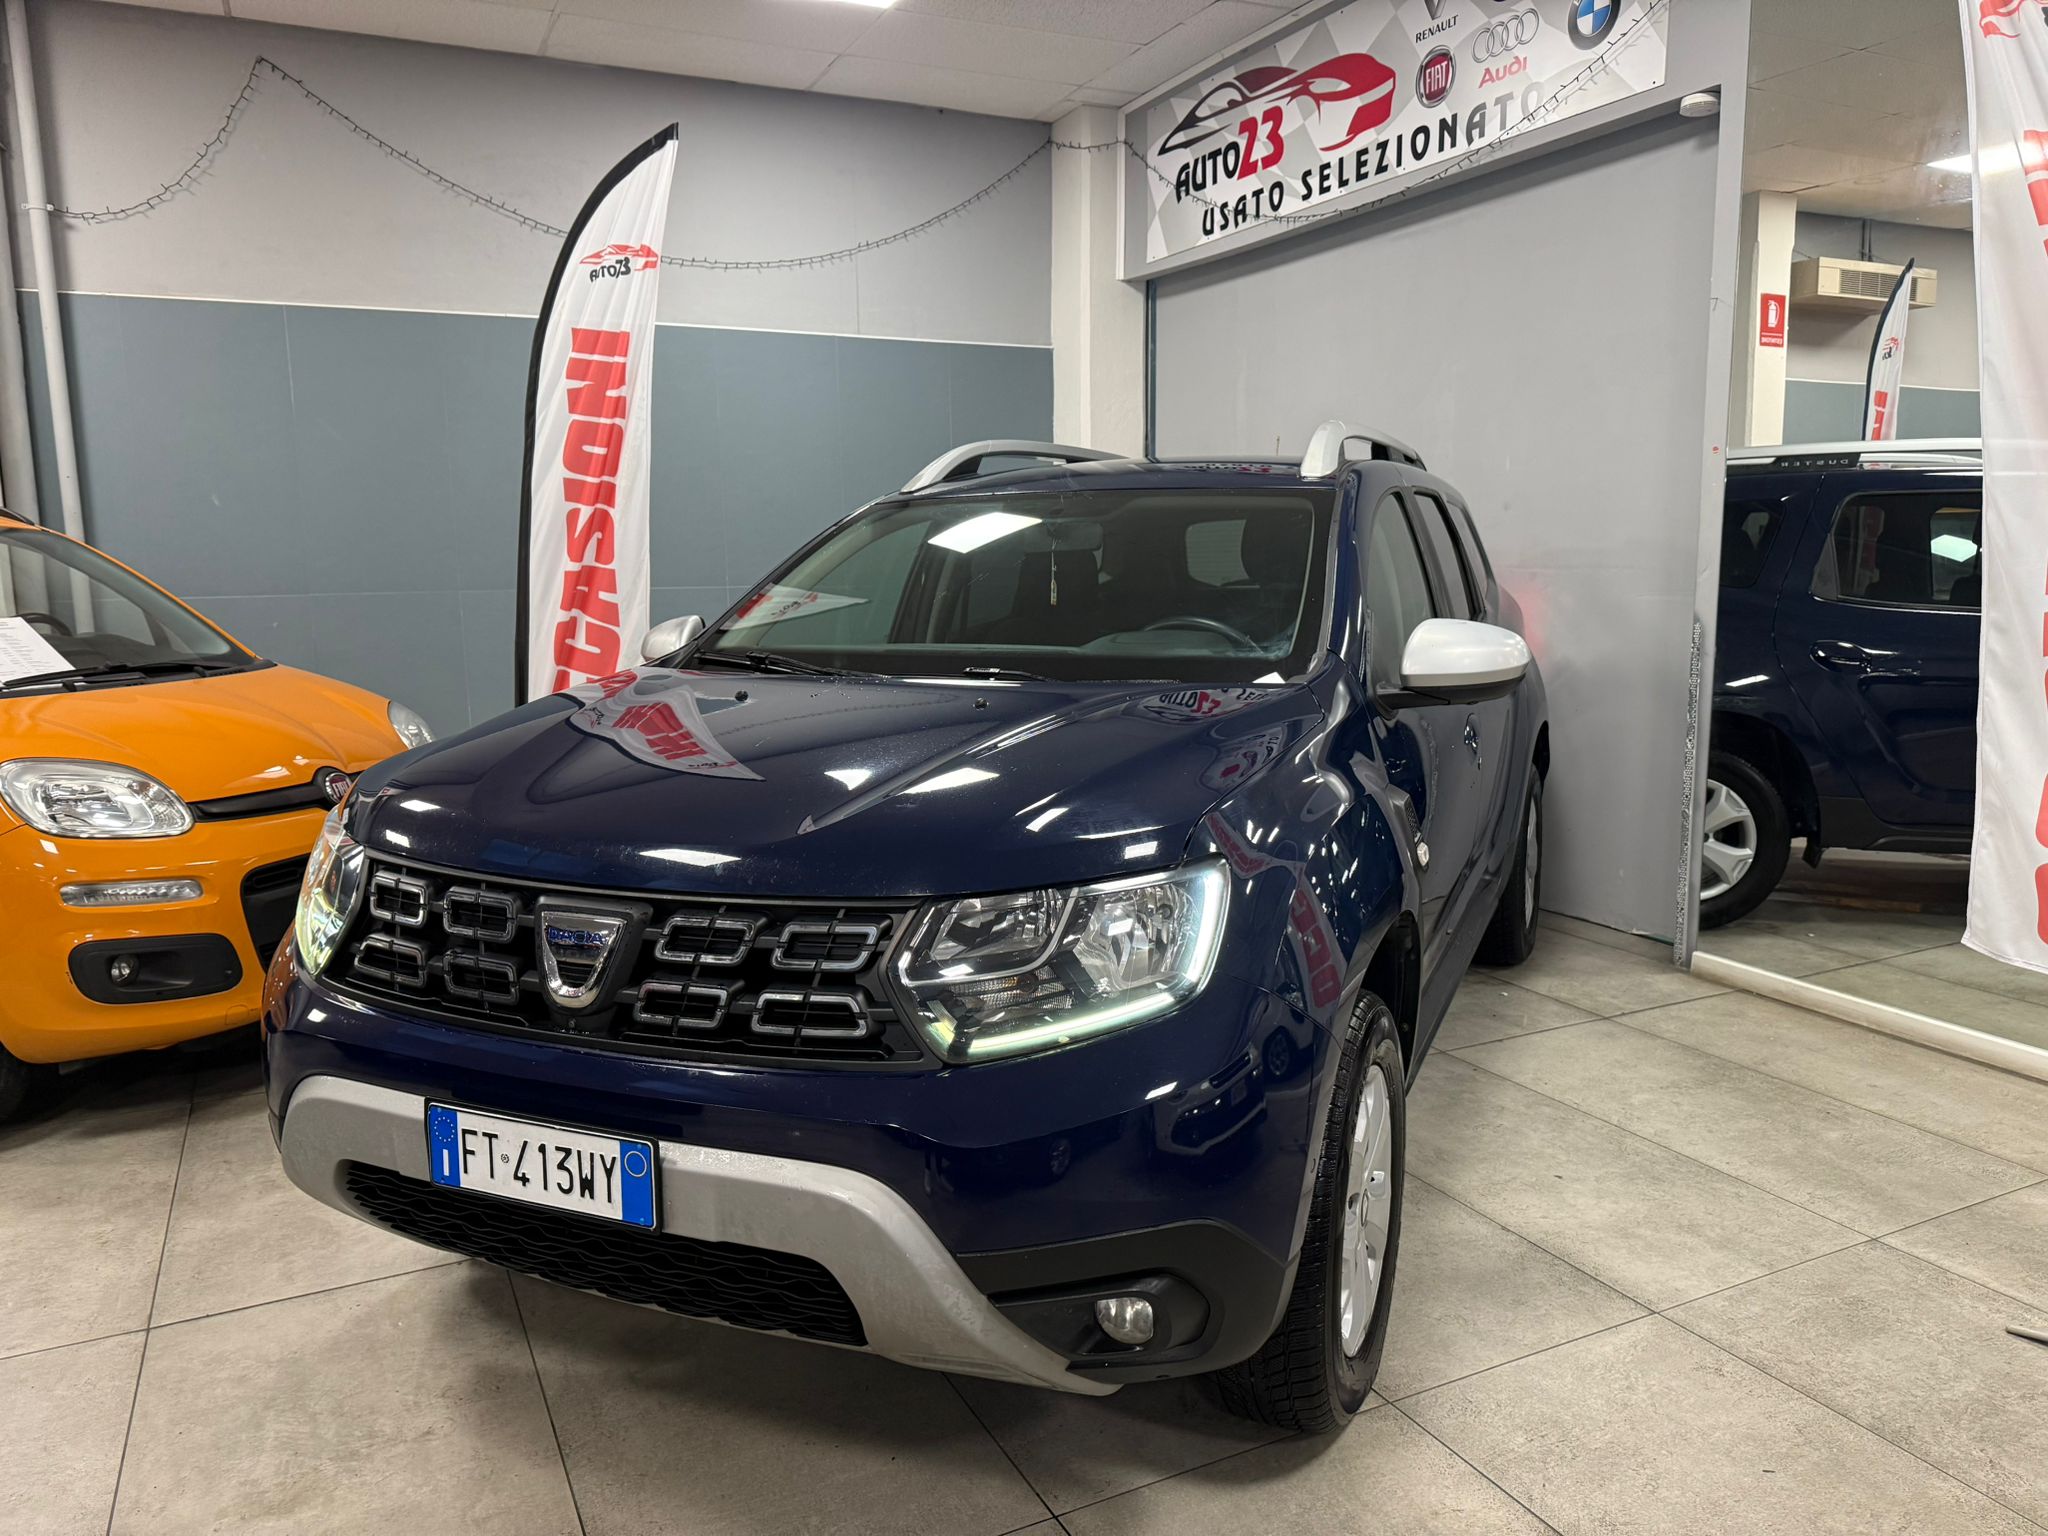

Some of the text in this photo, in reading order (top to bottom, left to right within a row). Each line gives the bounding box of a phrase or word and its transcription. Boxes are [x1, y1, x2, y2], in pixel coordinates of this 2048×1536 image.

[1415, 14, 1459, 43] RENAULT
[1425, 60, 1449, 94] FIAT
[1478, 55, 1528, 89] Audi
[1202, 81, 1546, 236] USATO SELEZIONATO
[332, 780, 348, 798] FIA
[461, 1128, 499, 1179] FT
[513, 1140, 617, 1203] 413WY
